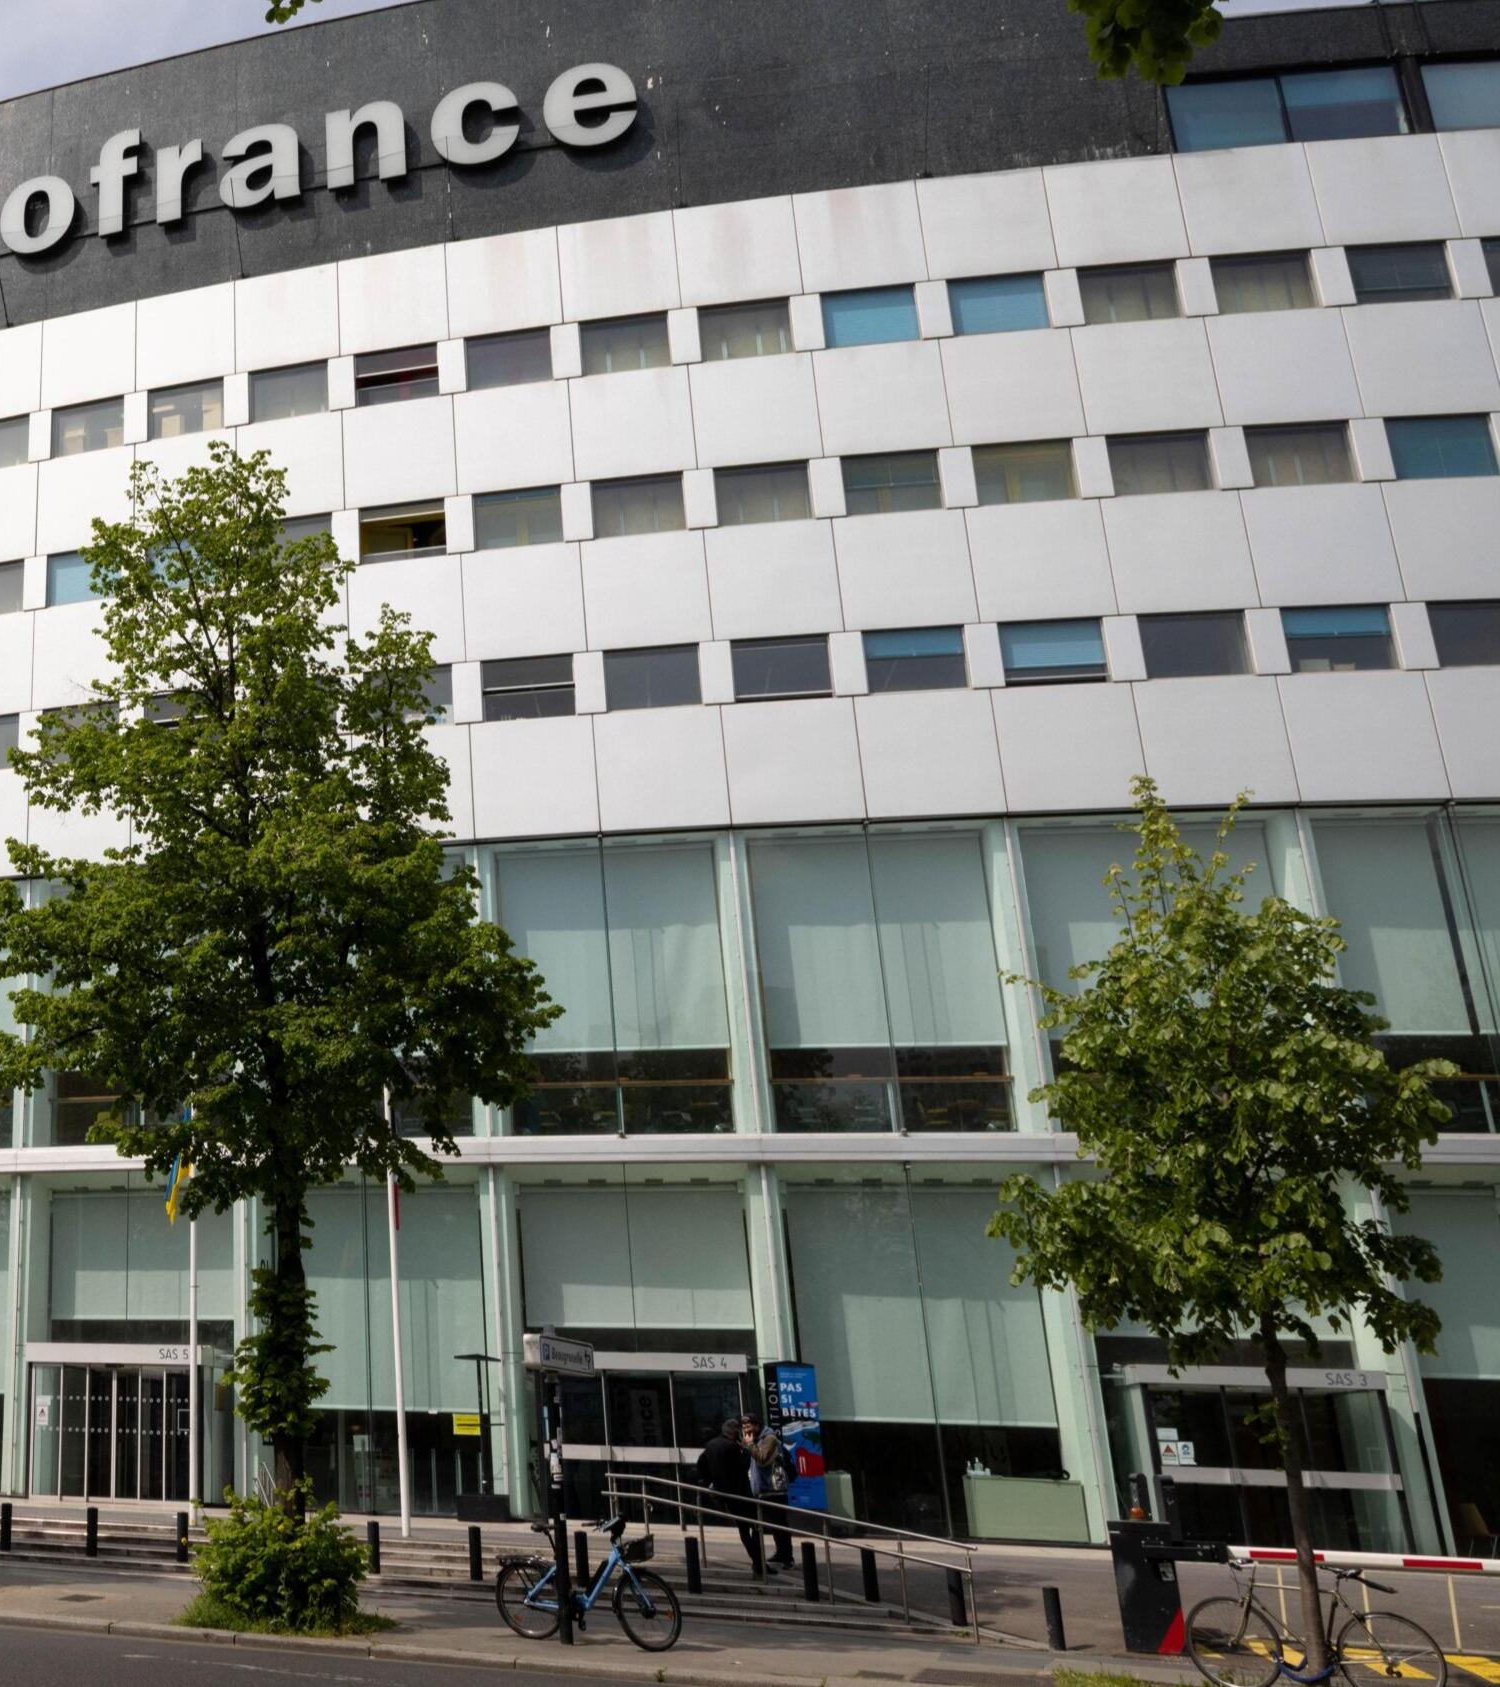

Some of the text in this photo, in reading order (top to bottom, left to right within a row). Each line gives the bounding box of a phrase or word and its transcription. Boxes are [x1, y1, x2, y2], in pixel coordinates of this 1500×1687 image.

[159, 1348, 189, 1360] SAS 5
[691, 1356, 728, 1369] SAS 4
[1325, 1372, 1368, 1387] SAS 3
[780, 1382, 803, 1393] PAS
[781, 1394, 793, 1404] SI
